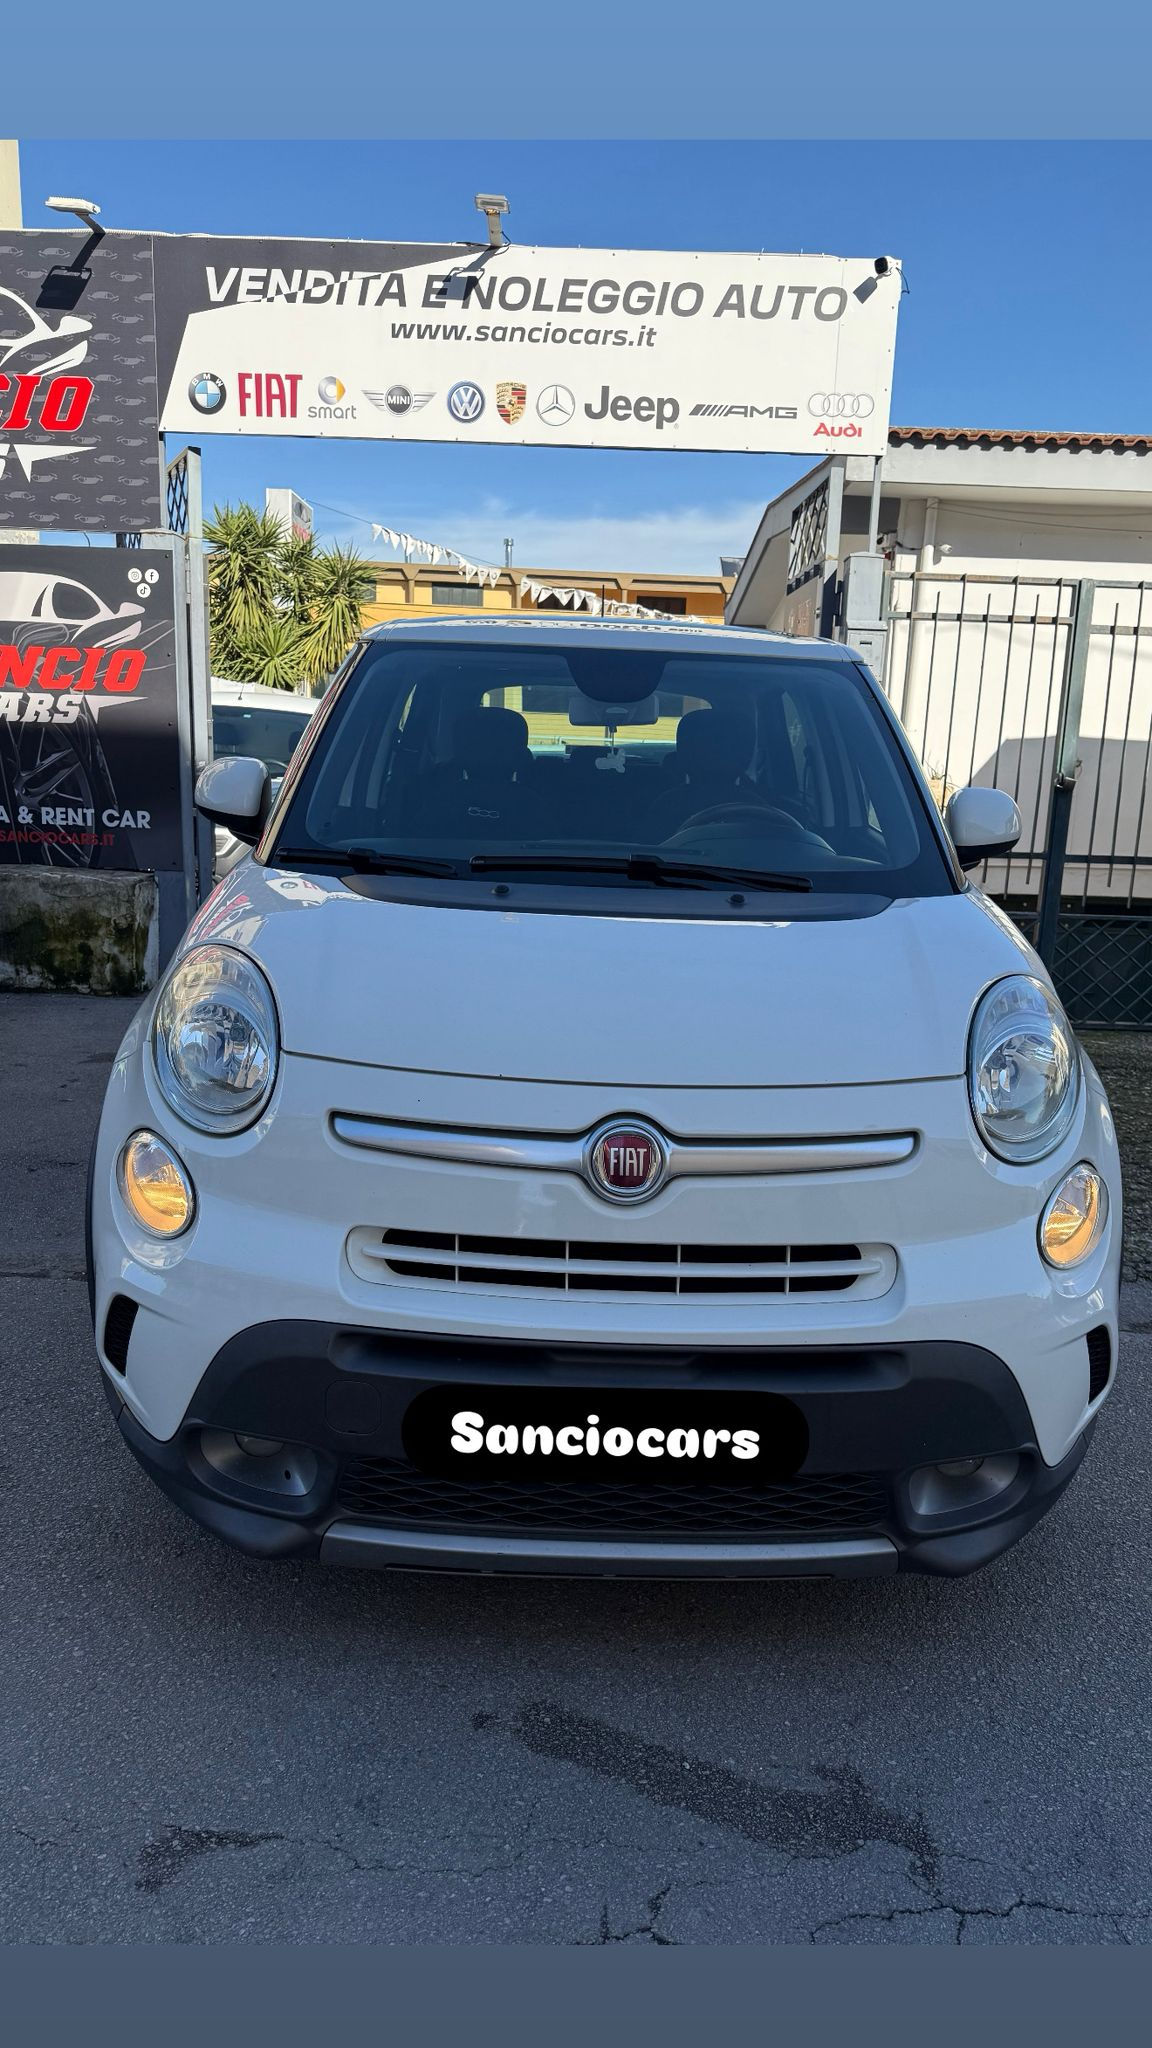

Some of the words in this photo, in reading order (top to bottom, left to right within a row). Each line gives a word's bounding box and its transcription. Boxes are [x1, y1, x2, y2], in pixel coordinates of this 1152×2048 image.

[205, 266, 407, 308] VENDITA
[421, 274, 452, 308] E
[461, 275, 705, 317] NOLEGGIO
[713, 283, 848, 322] AUTO
[391, 321, 657, 347] www.sanciocars.it
[238, 372, 303, 418] FIAT
[387, 395, 410, 405] MINI
[584, 386, 680, 429] Jeep
[307, 405, 357, 420] smart
[813, 422, 863, 437] Audi
[41, 806, 95, 827] RENT
[101, 808, 152, 830] CAR
[609, 1147, 648, 1177] FIAT
